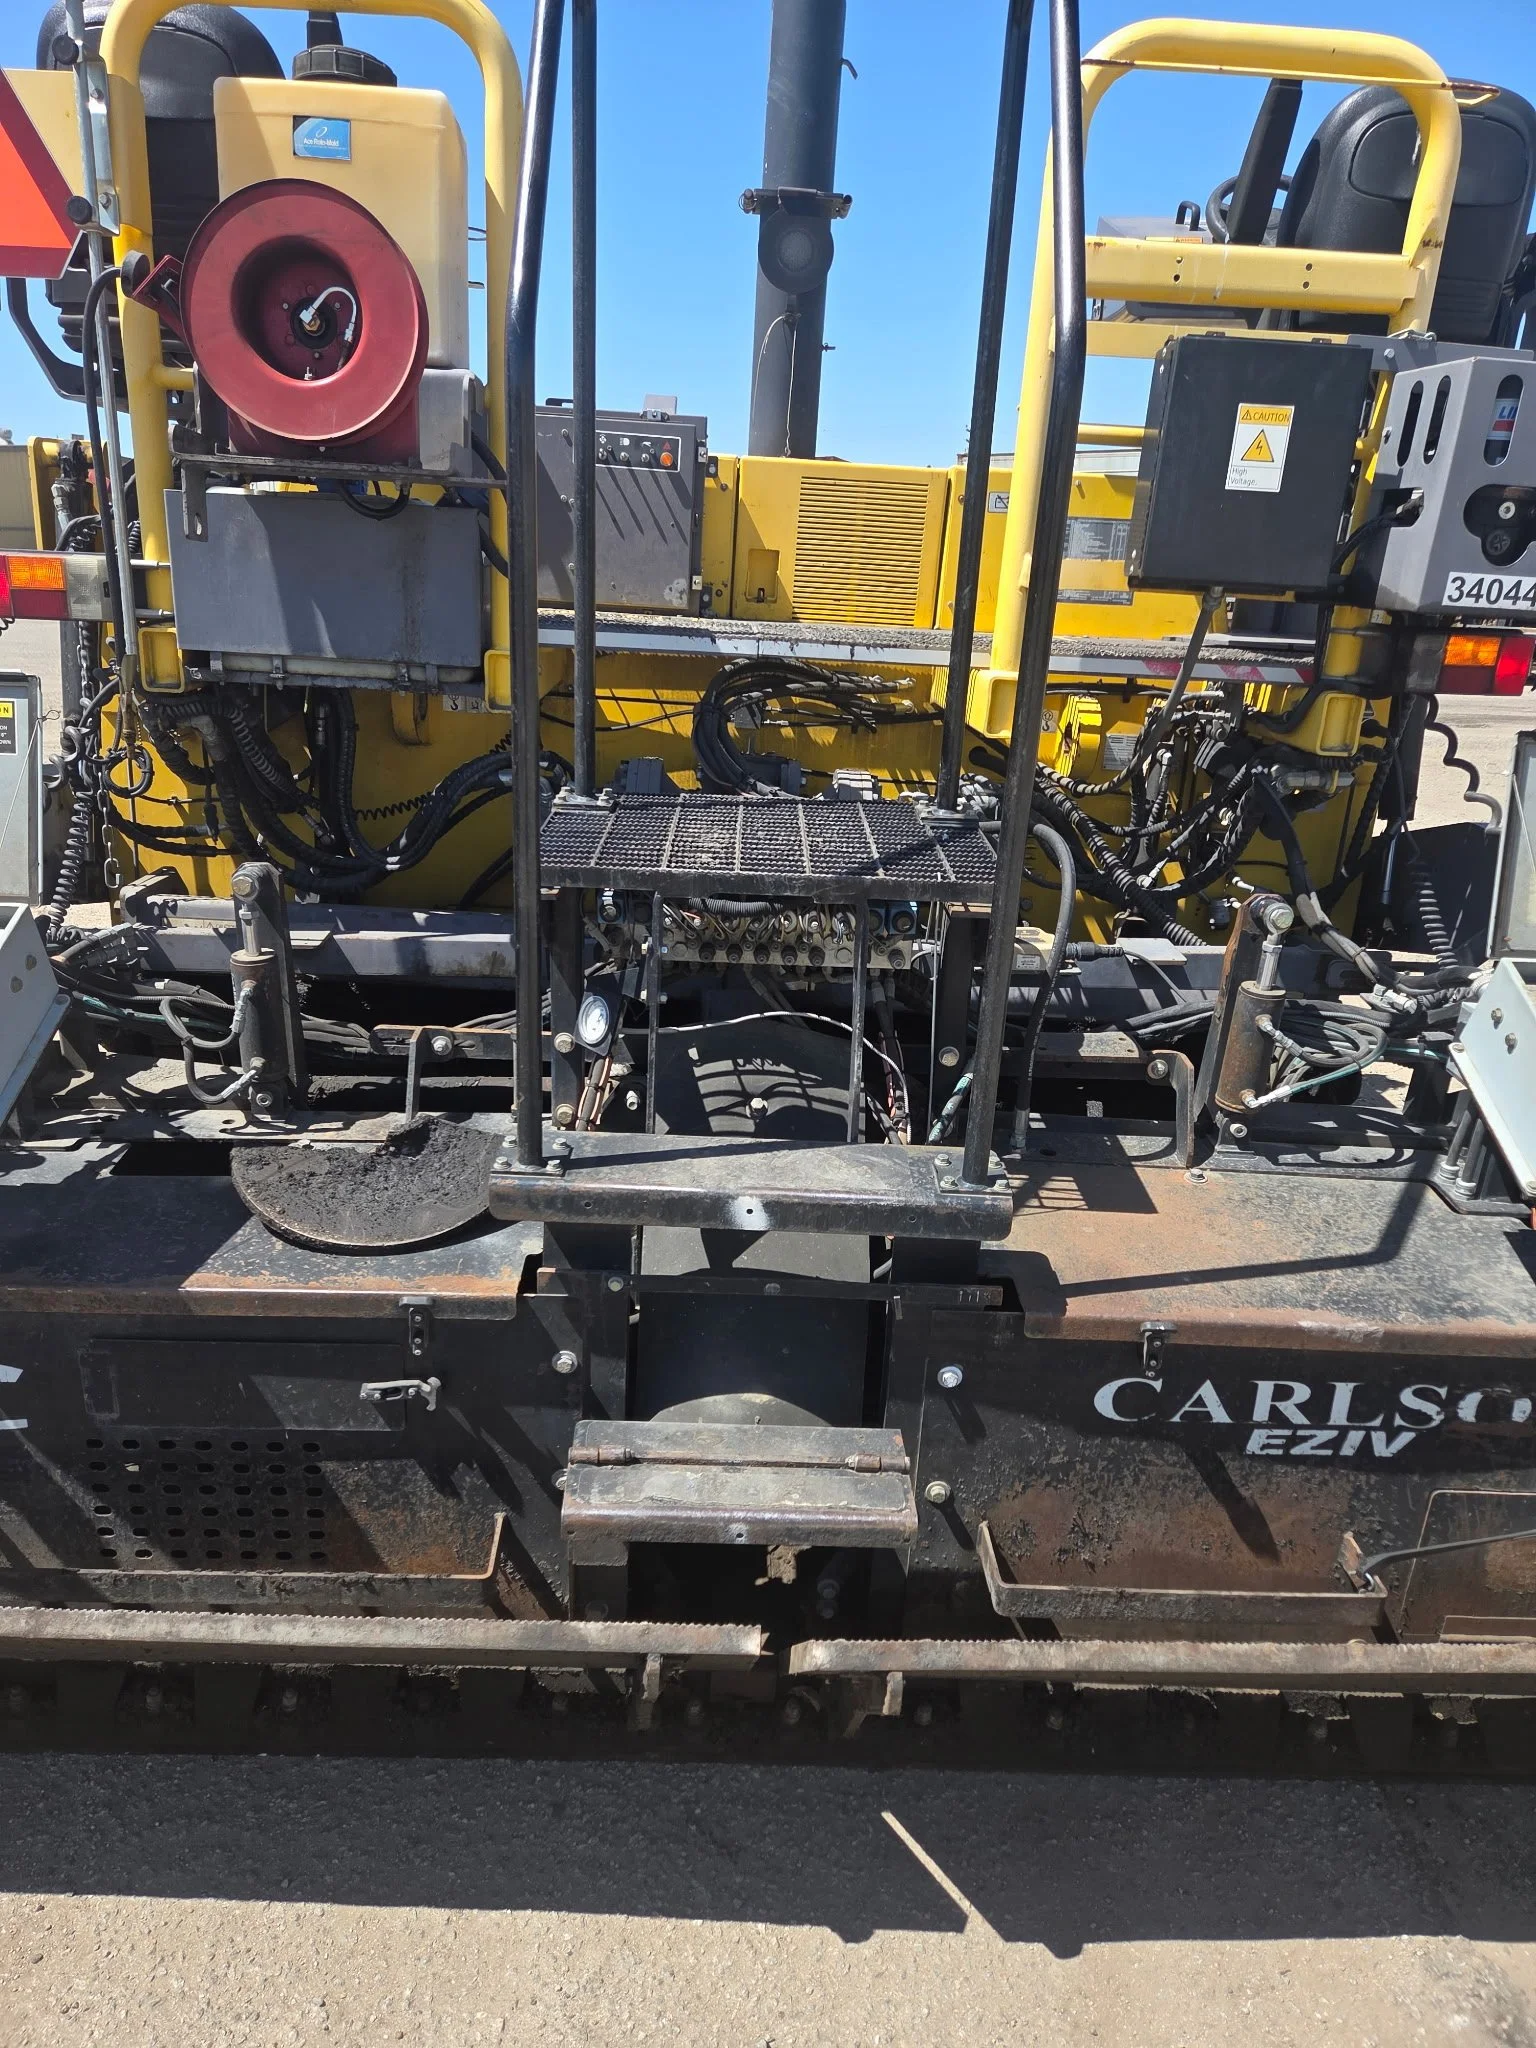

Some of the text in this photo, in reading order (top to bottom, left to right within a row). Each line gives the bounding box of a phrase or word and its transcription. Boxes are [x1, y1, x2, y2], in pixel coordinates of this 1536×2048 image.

[1253, 411, 1291, 422] CAUTION
[1232, 467, 1248, 476] High
[1446, 576, 1536, 608] 34044
[1246, 1428, 1416, 1457] EZIV
